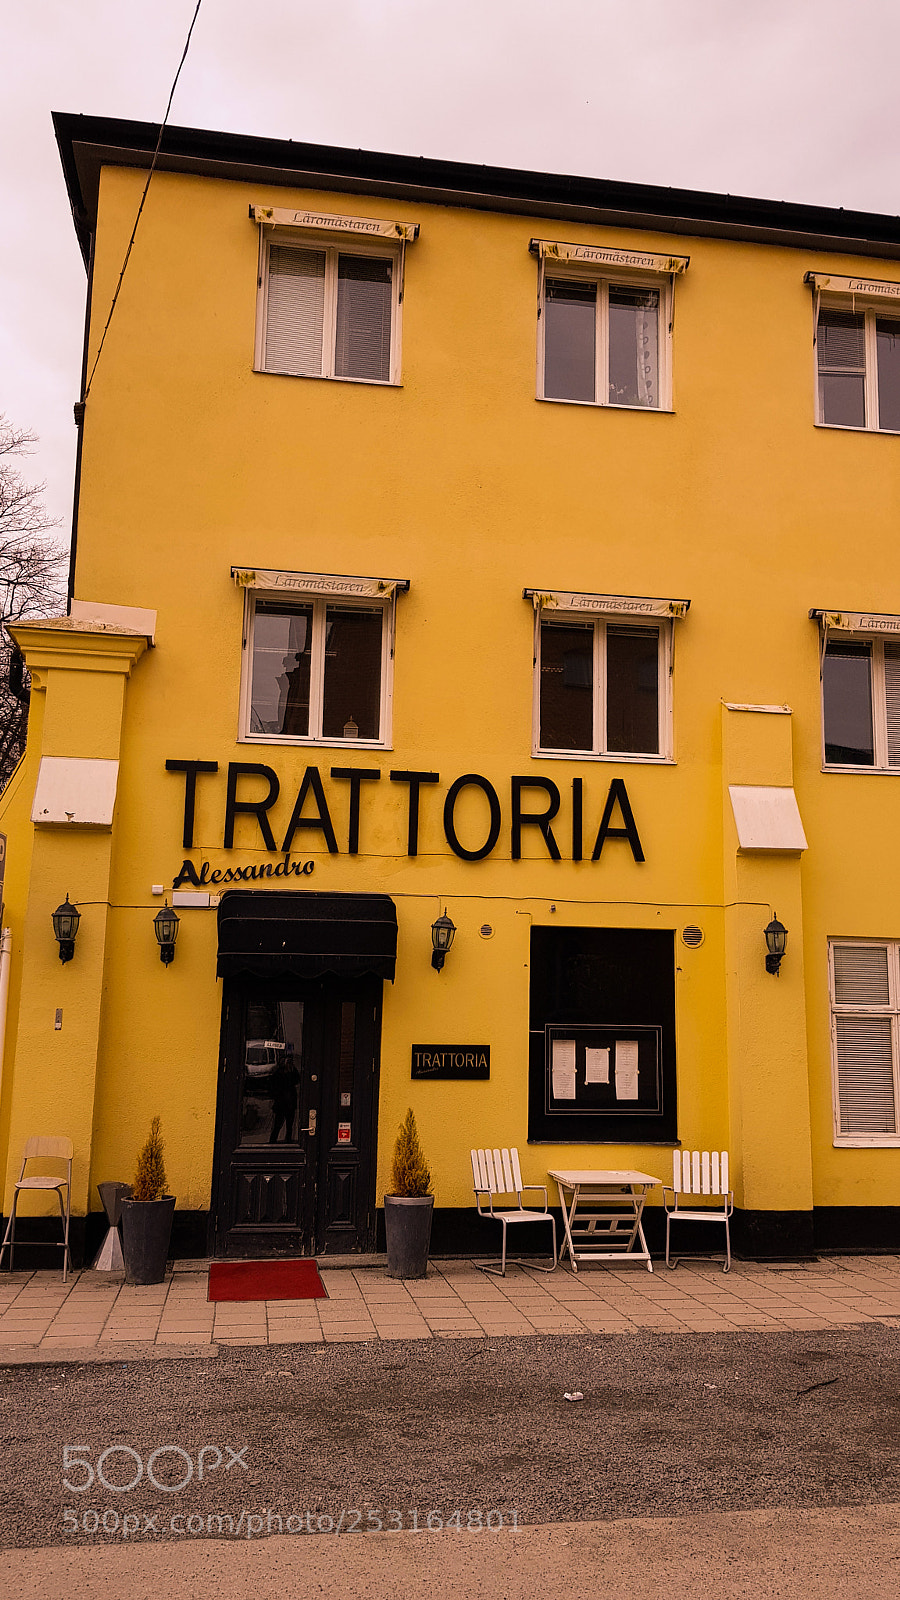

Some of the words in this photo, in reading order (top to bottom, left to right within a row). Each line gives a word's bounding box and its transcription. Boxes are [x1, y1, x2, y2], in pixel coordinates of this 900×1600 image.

[292, 211, 381, 232] Läromästaren
[573, 247, 654, 266] Läromästaren
[274, 574, 364, 592] Läromästaren
[569, 596, 654, 612] Läromästaren
[165, 759, 645, 863] TRATTORIA
[172, 853, 315, 889] Alessandro
[414, 1052, 488, 1068] TRATTORIA
